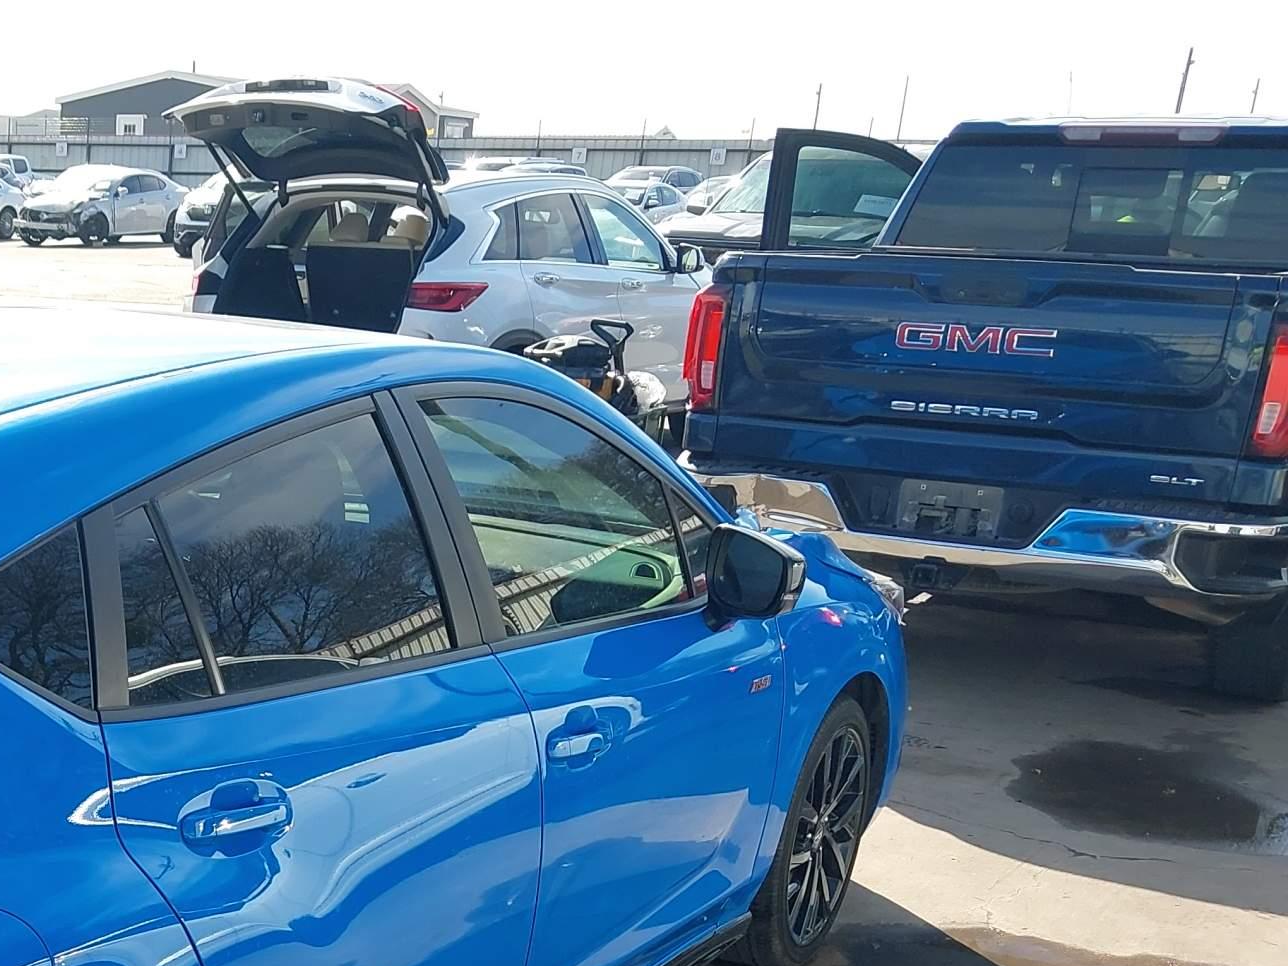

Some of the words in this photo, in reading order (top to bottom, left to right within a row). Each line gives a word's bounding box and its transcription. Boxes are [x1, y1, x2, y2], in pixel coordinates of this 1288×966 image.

[575, 151, 583, 161] 7
[895, 321, 1058, 357] GMC
[890, 400, 1039, 420] SIERRA
[1149, 474, 1205, 486] SLT
